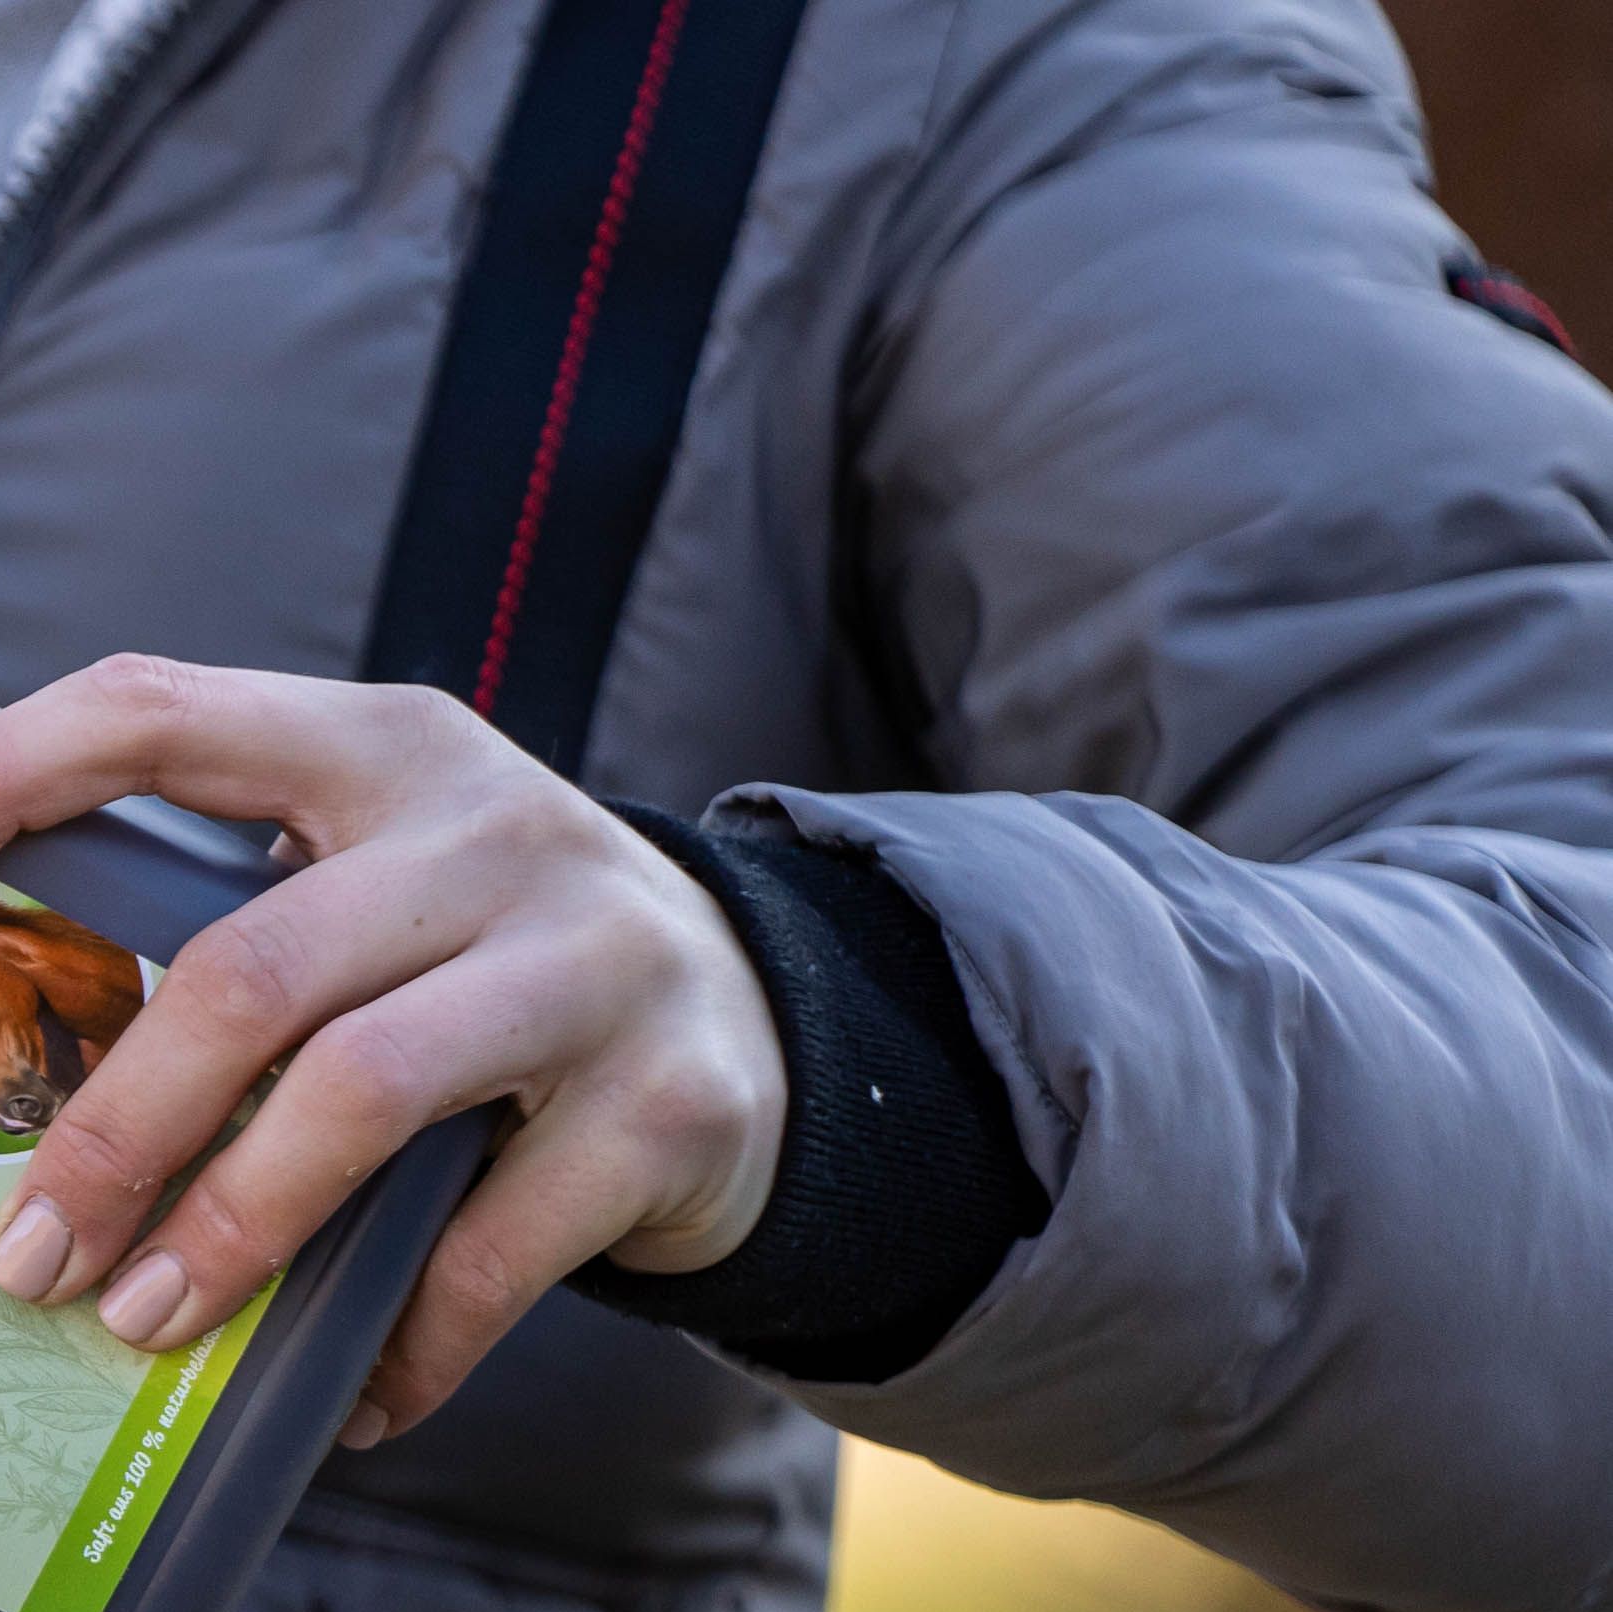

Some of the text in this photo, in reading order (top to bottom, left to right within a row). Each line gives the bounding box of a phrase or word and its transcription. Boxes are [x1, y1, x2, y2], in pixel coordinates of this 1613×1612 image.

[83, 1520, 116, 1563] Saft
[108, 1487, 135, 1521] aus
[123, 1450, 152, 1488] 100
[141, 1429, 166, 1450] %
